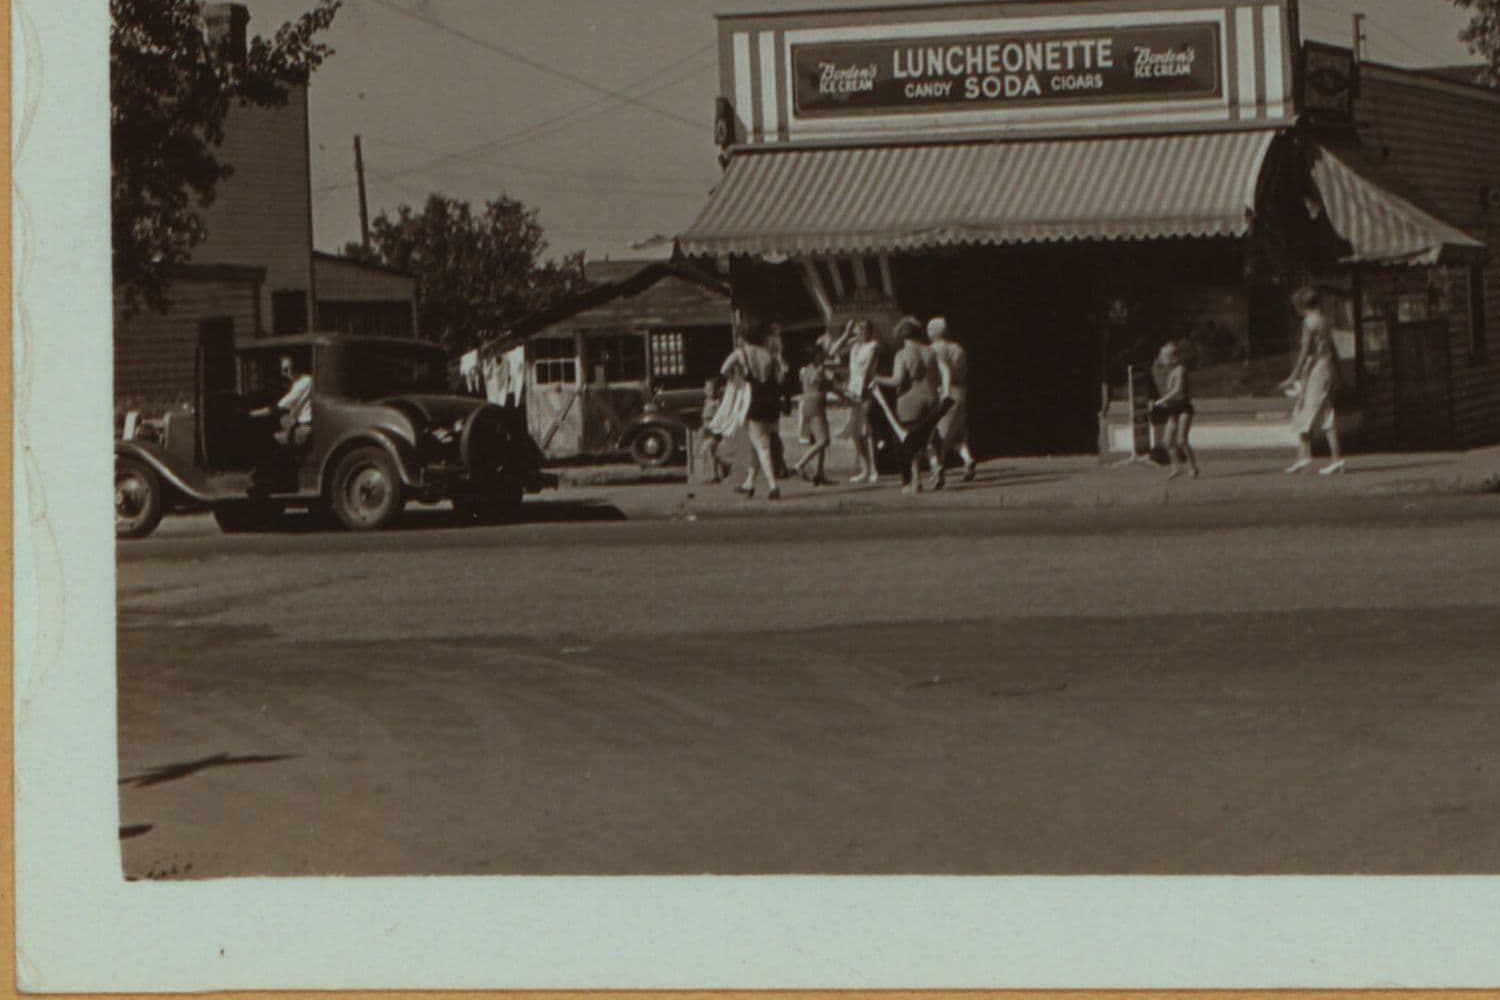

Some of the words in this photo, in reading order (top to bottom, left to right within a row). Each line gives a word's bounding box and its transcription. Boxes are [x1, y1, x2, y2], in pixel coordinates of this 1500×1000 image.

[892, 38, 1114, 79] LUNCHEONETTE
[1133, 46, 1196, 65] Borden's
[819, 62, 879, 81] Borden's
[1134, 64, 1152, 79] ICE
[1153, 62, 1192, 78] CREAM
[819, 79, 836, 94] ICE
[838, 77, 874, 93] CREAM
[904, 80, 952, 98] CANDY
[964, 74, 1042, 99] SODA
[1050, 74, 1104, 92] CIGARS
